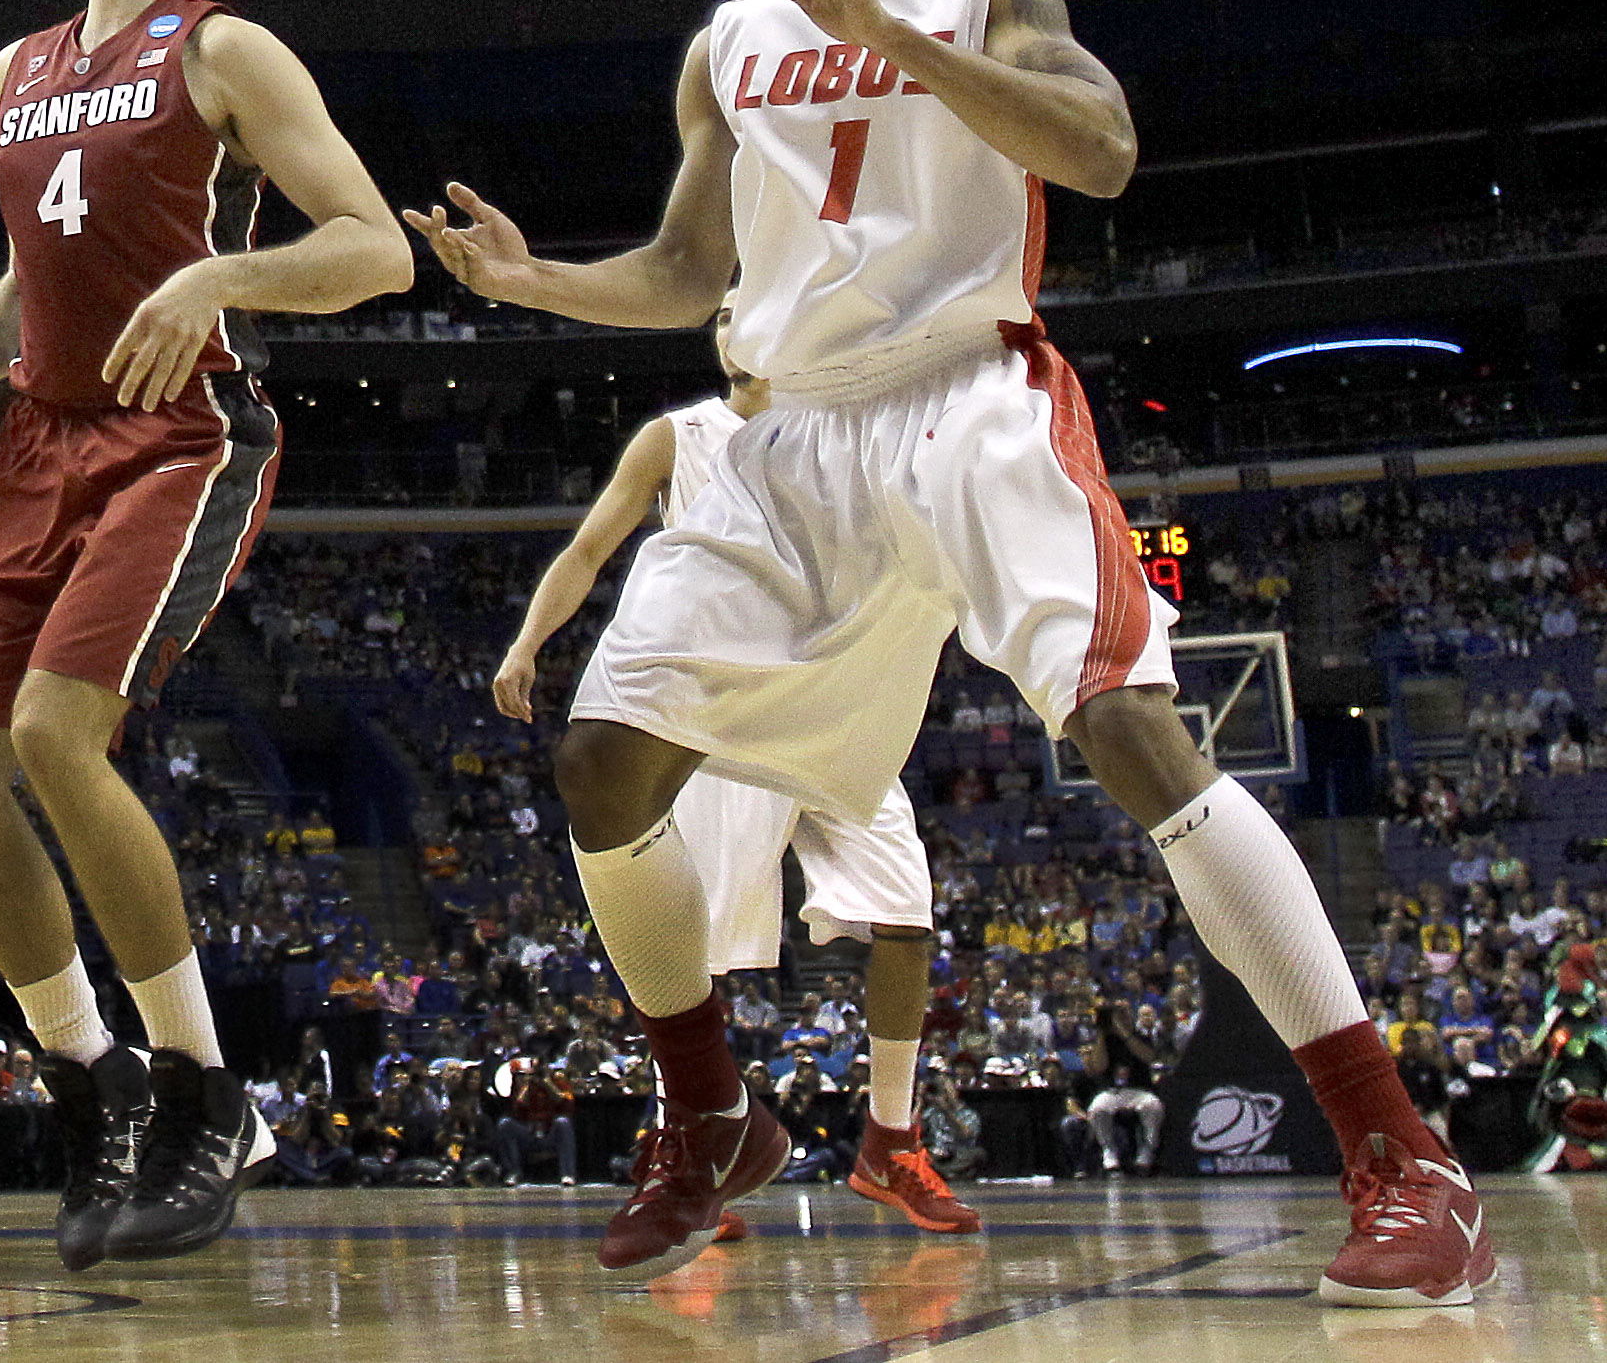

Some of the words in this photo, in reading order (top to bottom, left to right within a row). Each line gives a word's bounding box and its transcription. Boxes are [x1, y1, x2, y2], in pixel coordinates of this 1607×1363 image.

[734, 31, 956, 111] LOBO
[37, 148, 88, 236] 4
[819, 119, 871, 225] 1
